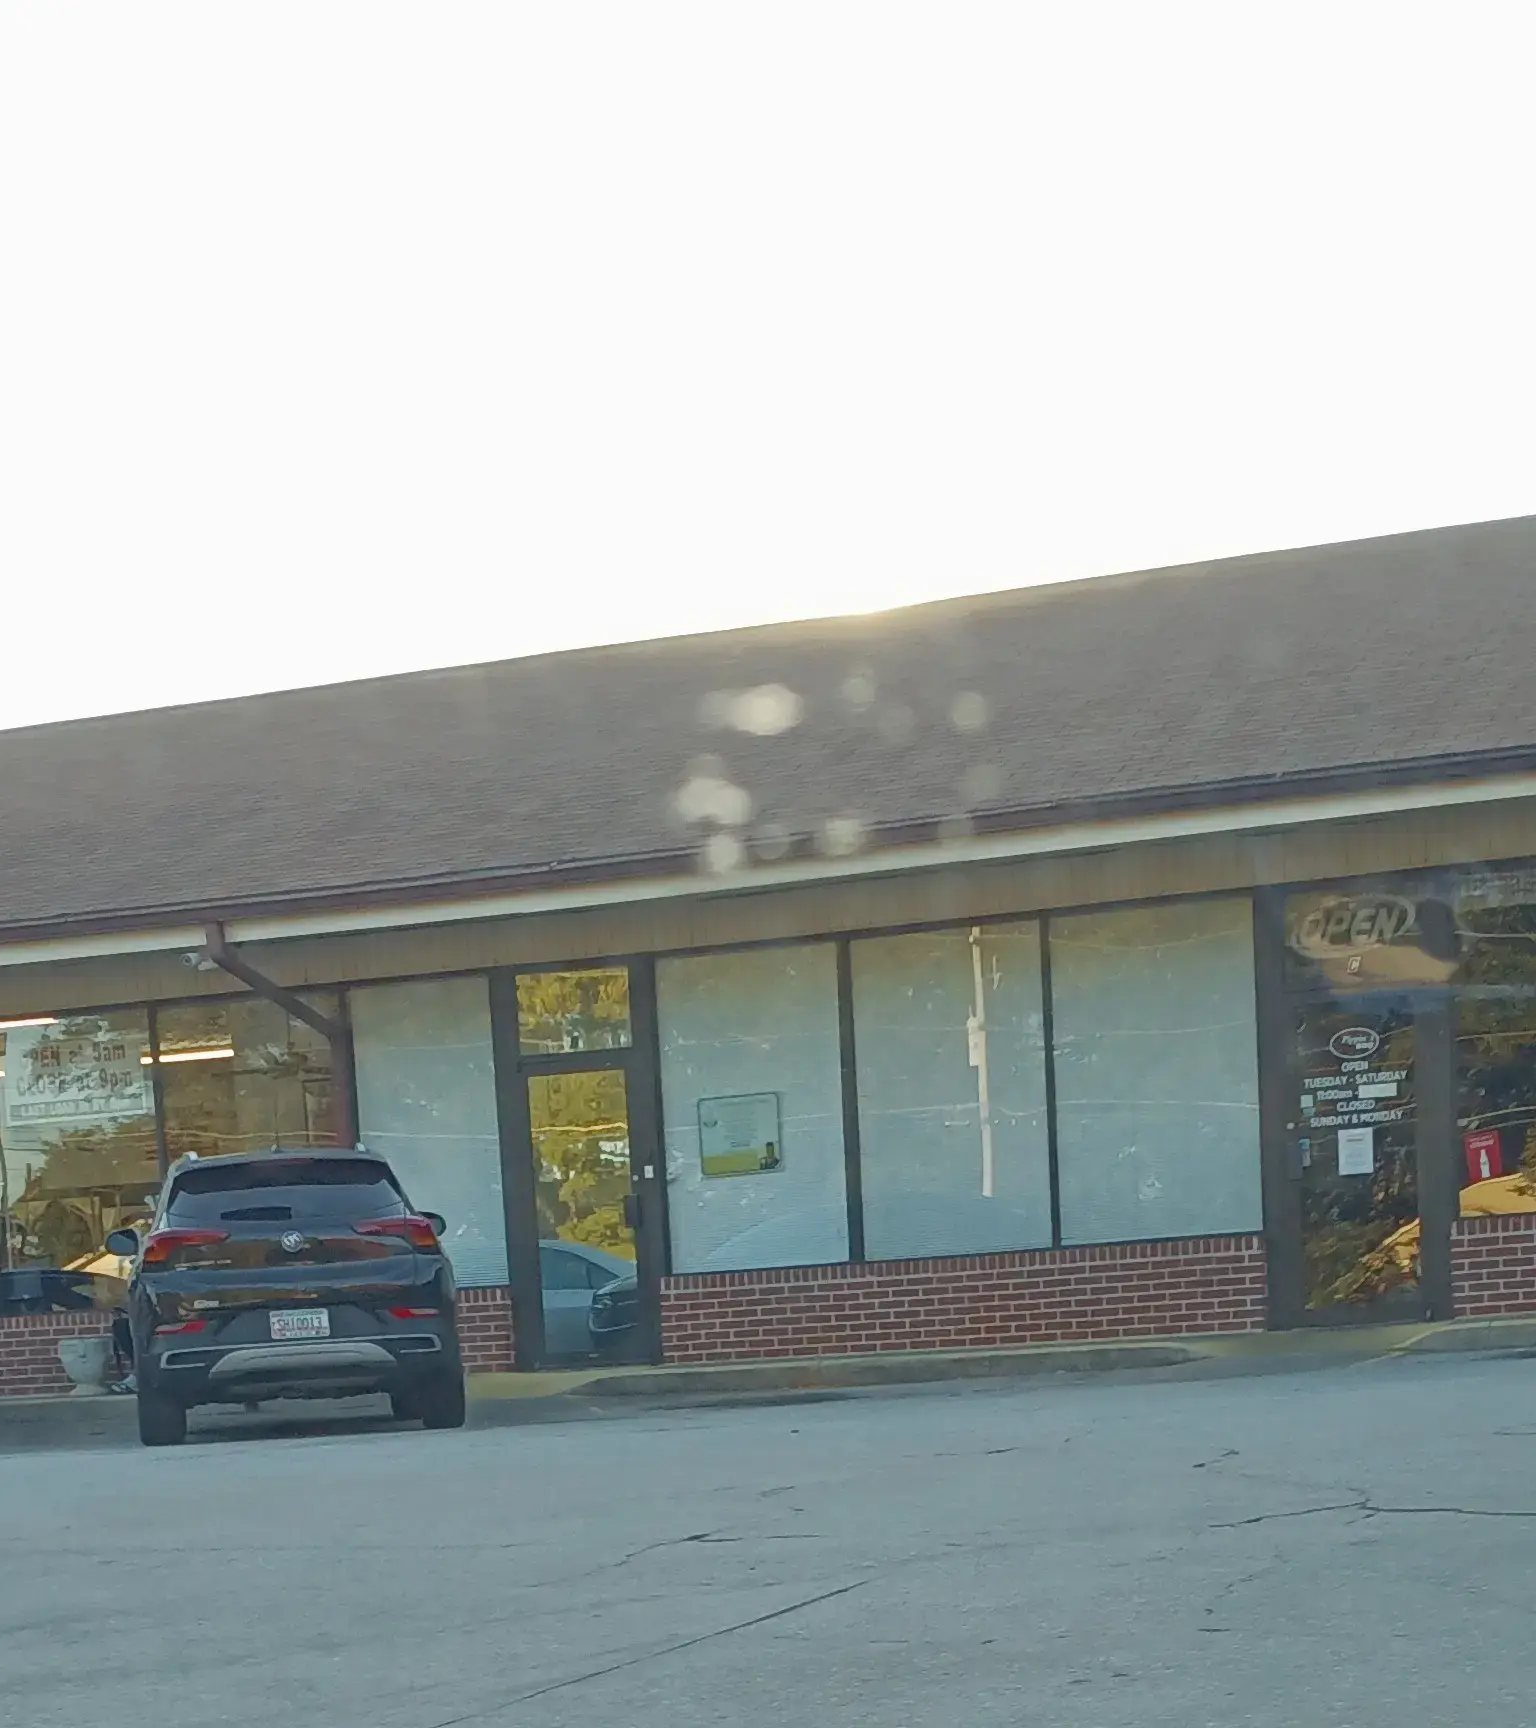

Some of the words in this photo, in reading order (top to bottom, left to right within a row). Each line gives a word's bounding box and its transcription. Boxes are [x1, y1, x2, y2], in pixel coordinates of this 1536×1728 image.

[1298, 906, 1400, 948] OPEN
[1341, 1060, 1369, 1072] OPEN
[1304, 1075, 1348, 1089] TUESDAY
[1355, 1070, 1408, 1084] SATURDAY
[1336, 1100, 1376, 1112] CLOSED
[1310, 1113, 1350, 1128] SUNDAY
[1359, 1110, 1404, 1122] MONDAY
